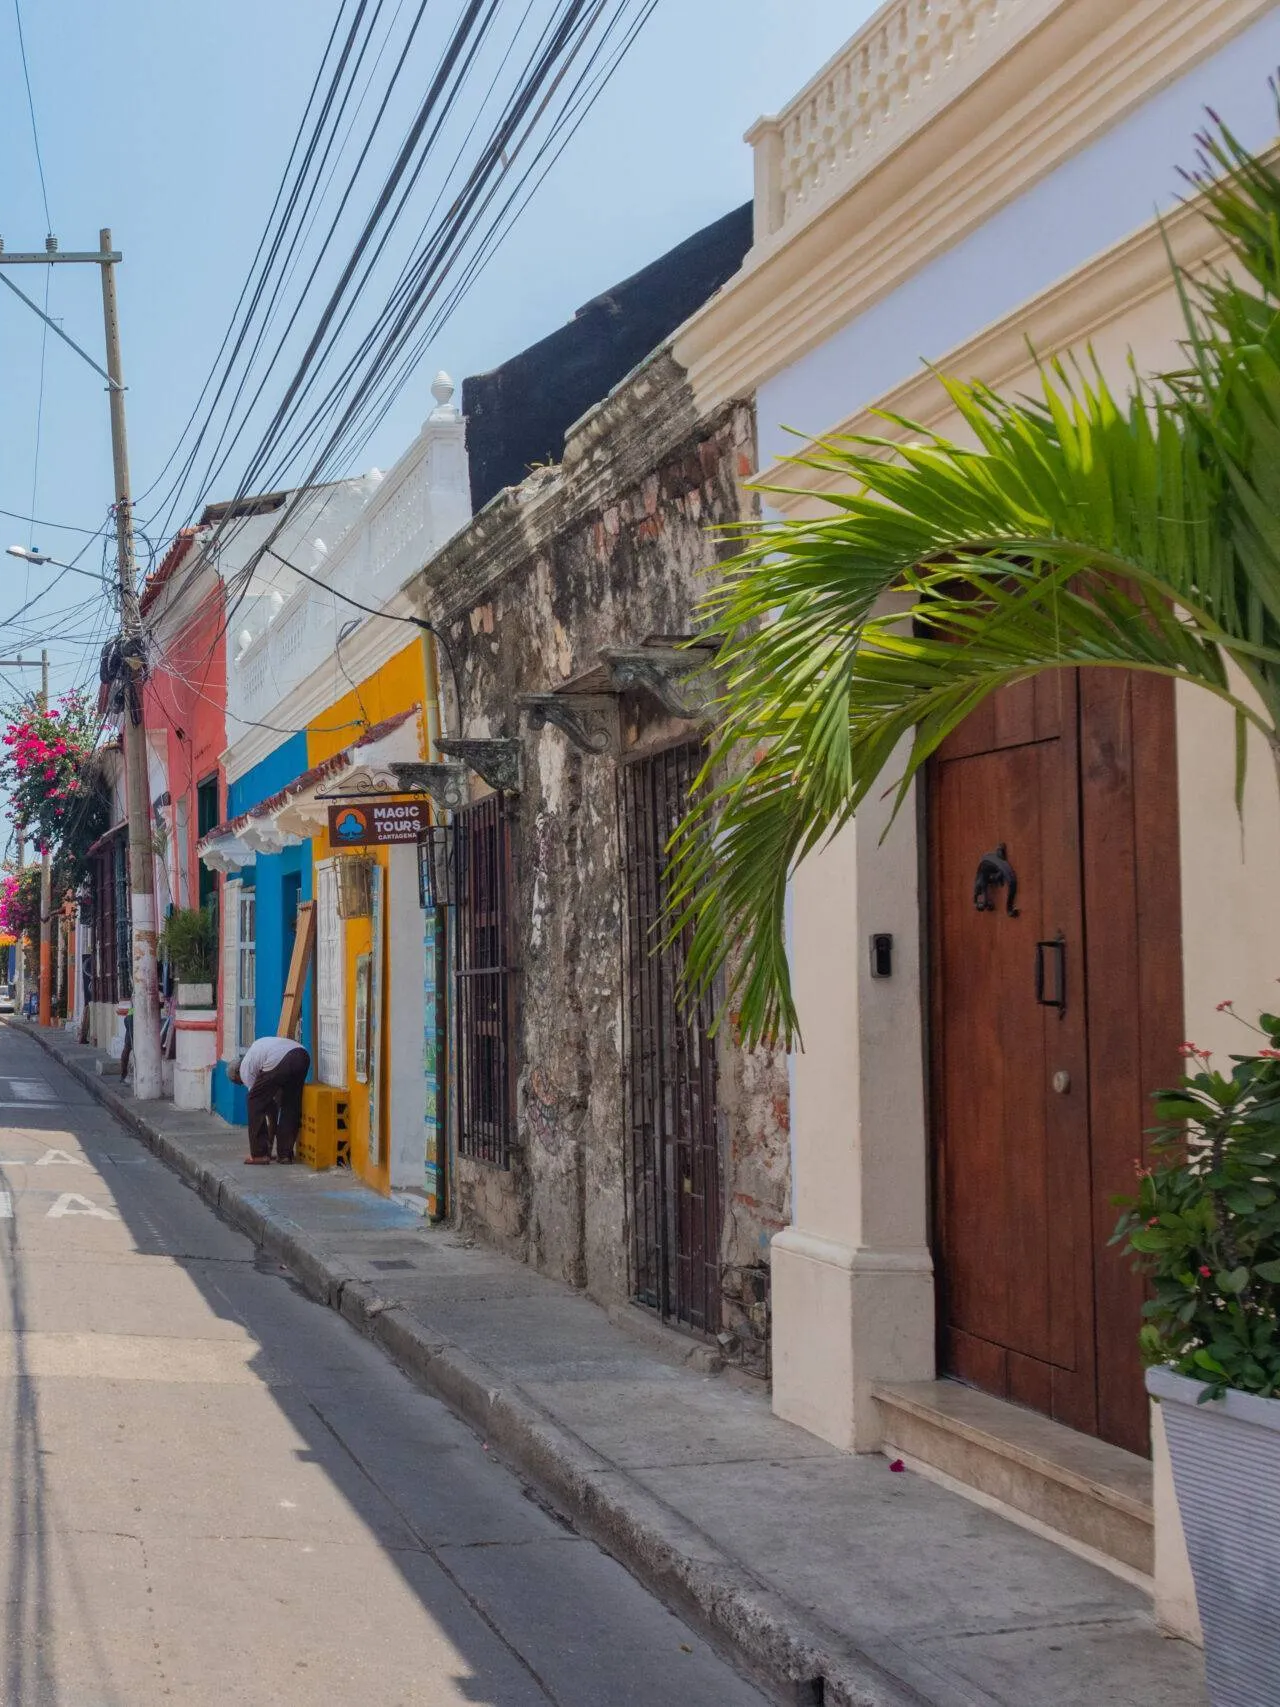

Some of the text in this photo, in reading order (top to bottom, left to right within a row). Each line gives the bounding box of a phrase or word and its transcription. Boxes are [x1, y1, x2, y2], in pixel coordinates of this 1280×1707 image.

[373, 806, 419, 818] MAGIC
[375, 820, 421, 832] TOURS
[378, 832, 417, 840] CARTAGENA
